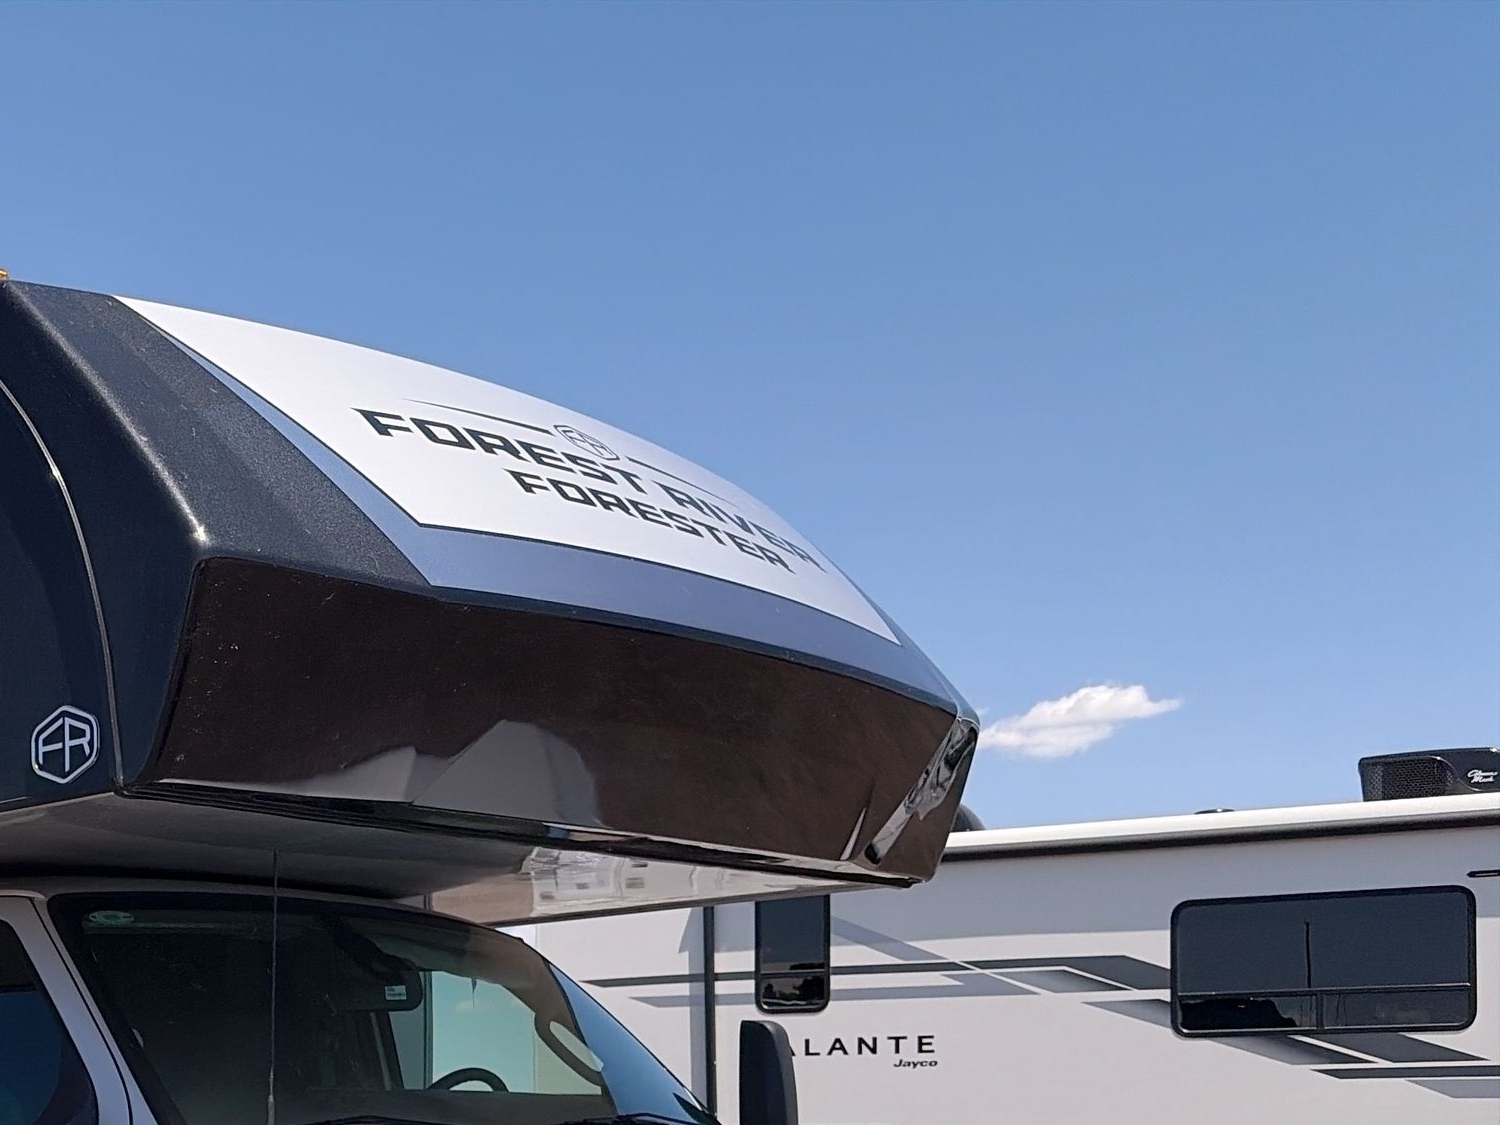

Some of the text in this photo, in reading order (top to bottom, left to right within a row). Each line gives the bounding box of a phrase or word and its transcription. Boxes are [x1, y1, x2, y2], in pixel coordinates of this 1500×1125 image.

[350, 407, 828, 575] FOREST RIVER
[504, 468, 797, 576] FORESTER
[38, 716, 91, 773] FR
[789, 1035, 935, 1056] LANTE
[893, 1058, 939, 1069] Jayco
